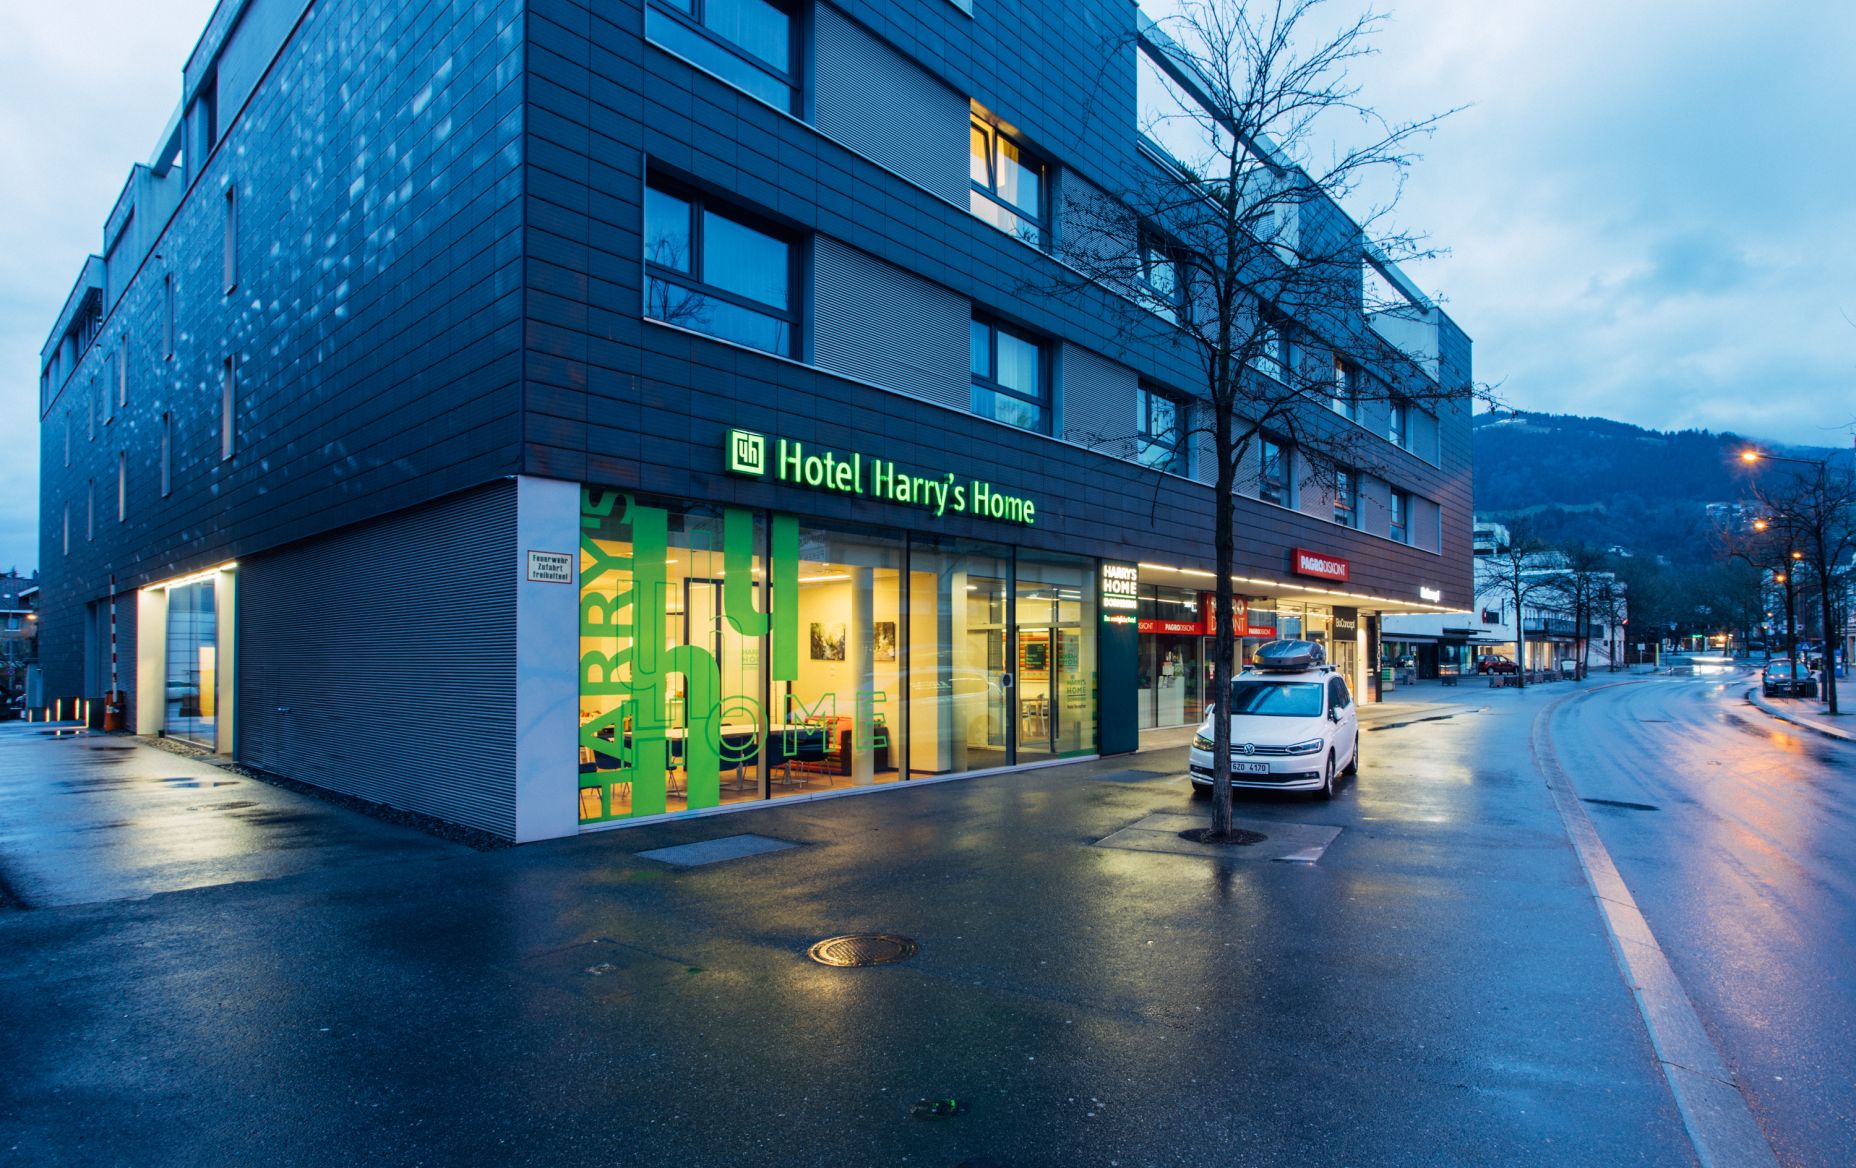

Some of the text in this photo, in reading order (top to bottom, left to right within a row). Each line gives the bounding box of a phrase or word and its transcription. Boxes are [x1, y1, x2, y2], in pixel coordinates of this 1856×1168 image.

[777, 438, 1036, 525] Hotel Harry's Home
[532, 554, 568, 564] Feuerwehr
[538, 563, 563, 572] Zufahrt
[532, 570, 568, 581] freihalten!
[1103, 579, 1137, 595] HOME
[1210, 596, 1245, 616] PRO
[579, 488, 634, 824] HARRY'S
[1249, 764, 1266, 772] 4170
